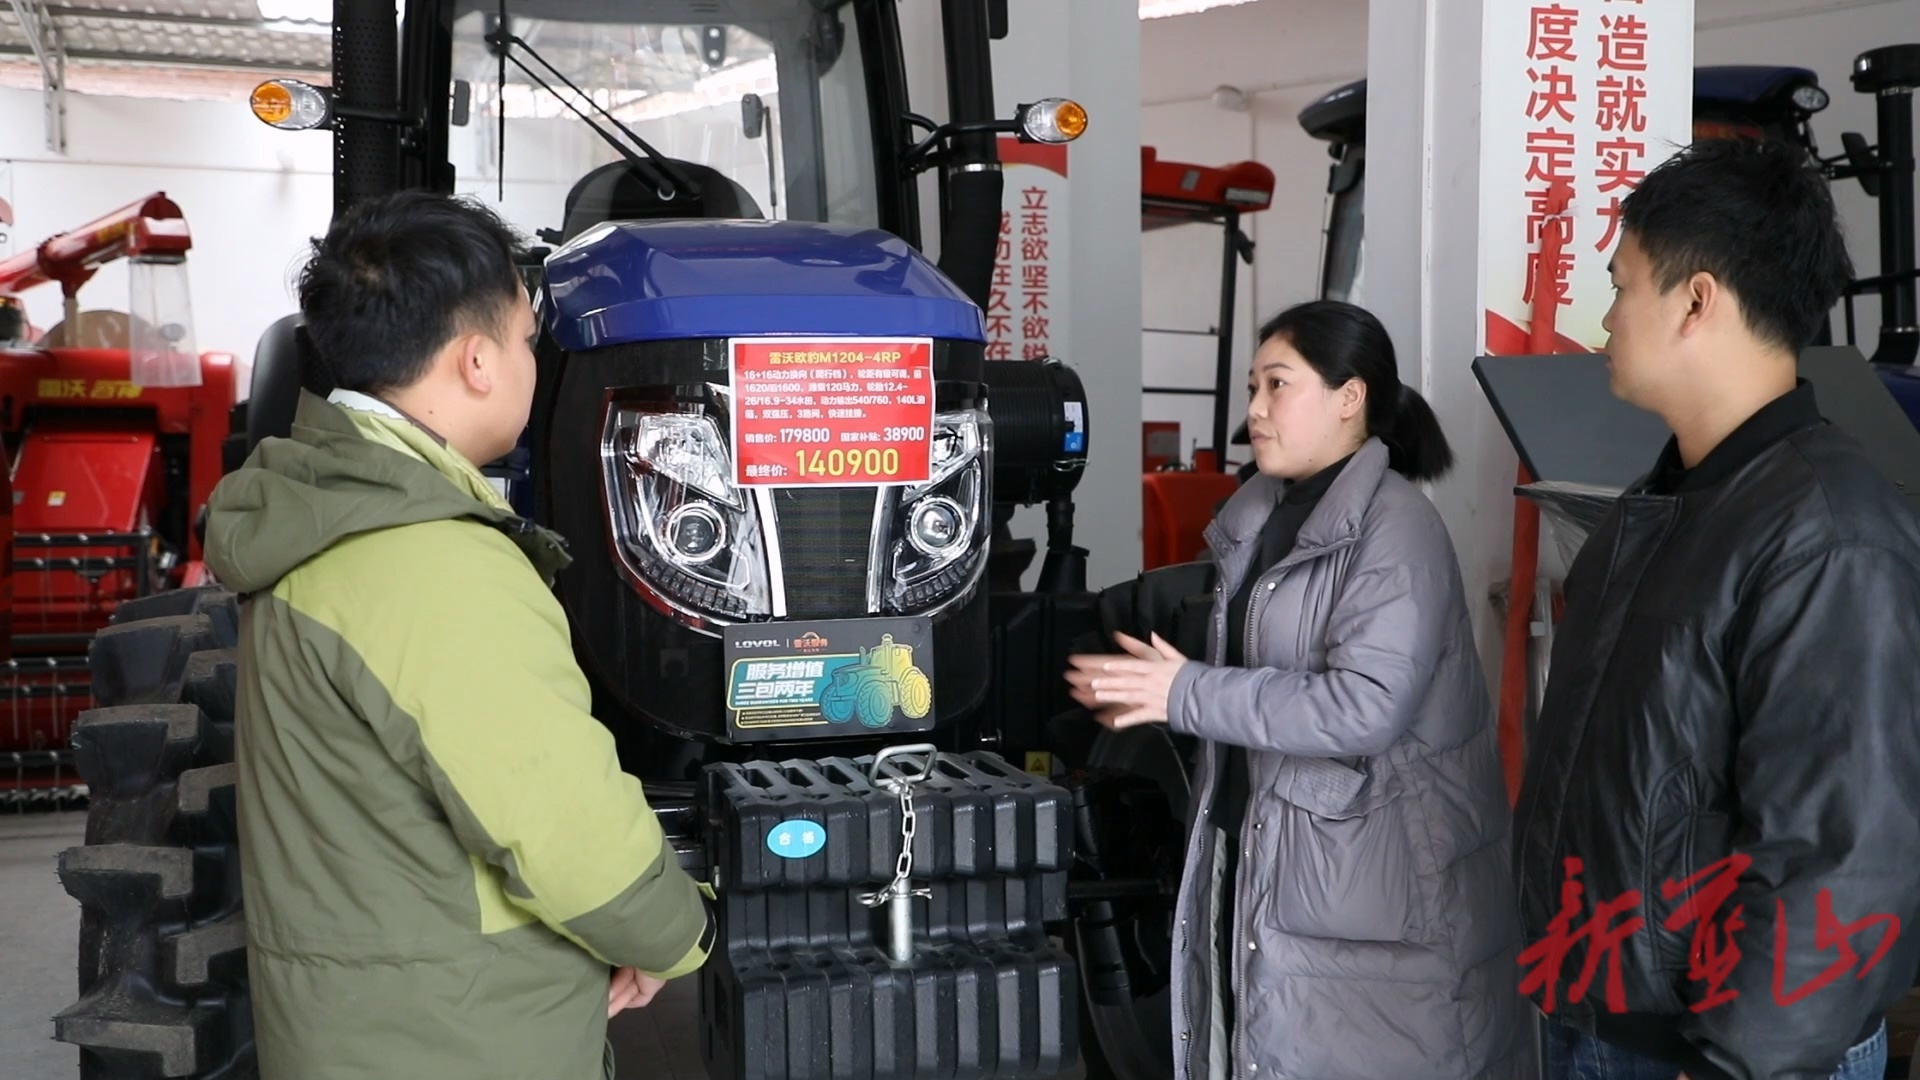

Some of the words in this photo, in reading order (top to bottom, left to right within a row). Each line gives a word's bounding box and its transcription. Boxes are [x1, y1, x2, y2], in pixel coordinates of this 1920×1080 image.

[769, 351, 902, 364] 雷沃欧豹M1204-4RP
[779, 428, 831, 443] 179800
[883, 426, 925, 442] 38900
[795, 448, 899, 477] 140900
[735, 639, 780, 649] LOVOL
[746, 661, 825, 681] 服务增值
[735, 680, 816, 700] 三包两年
[779, 831, 815, 846] 合格
